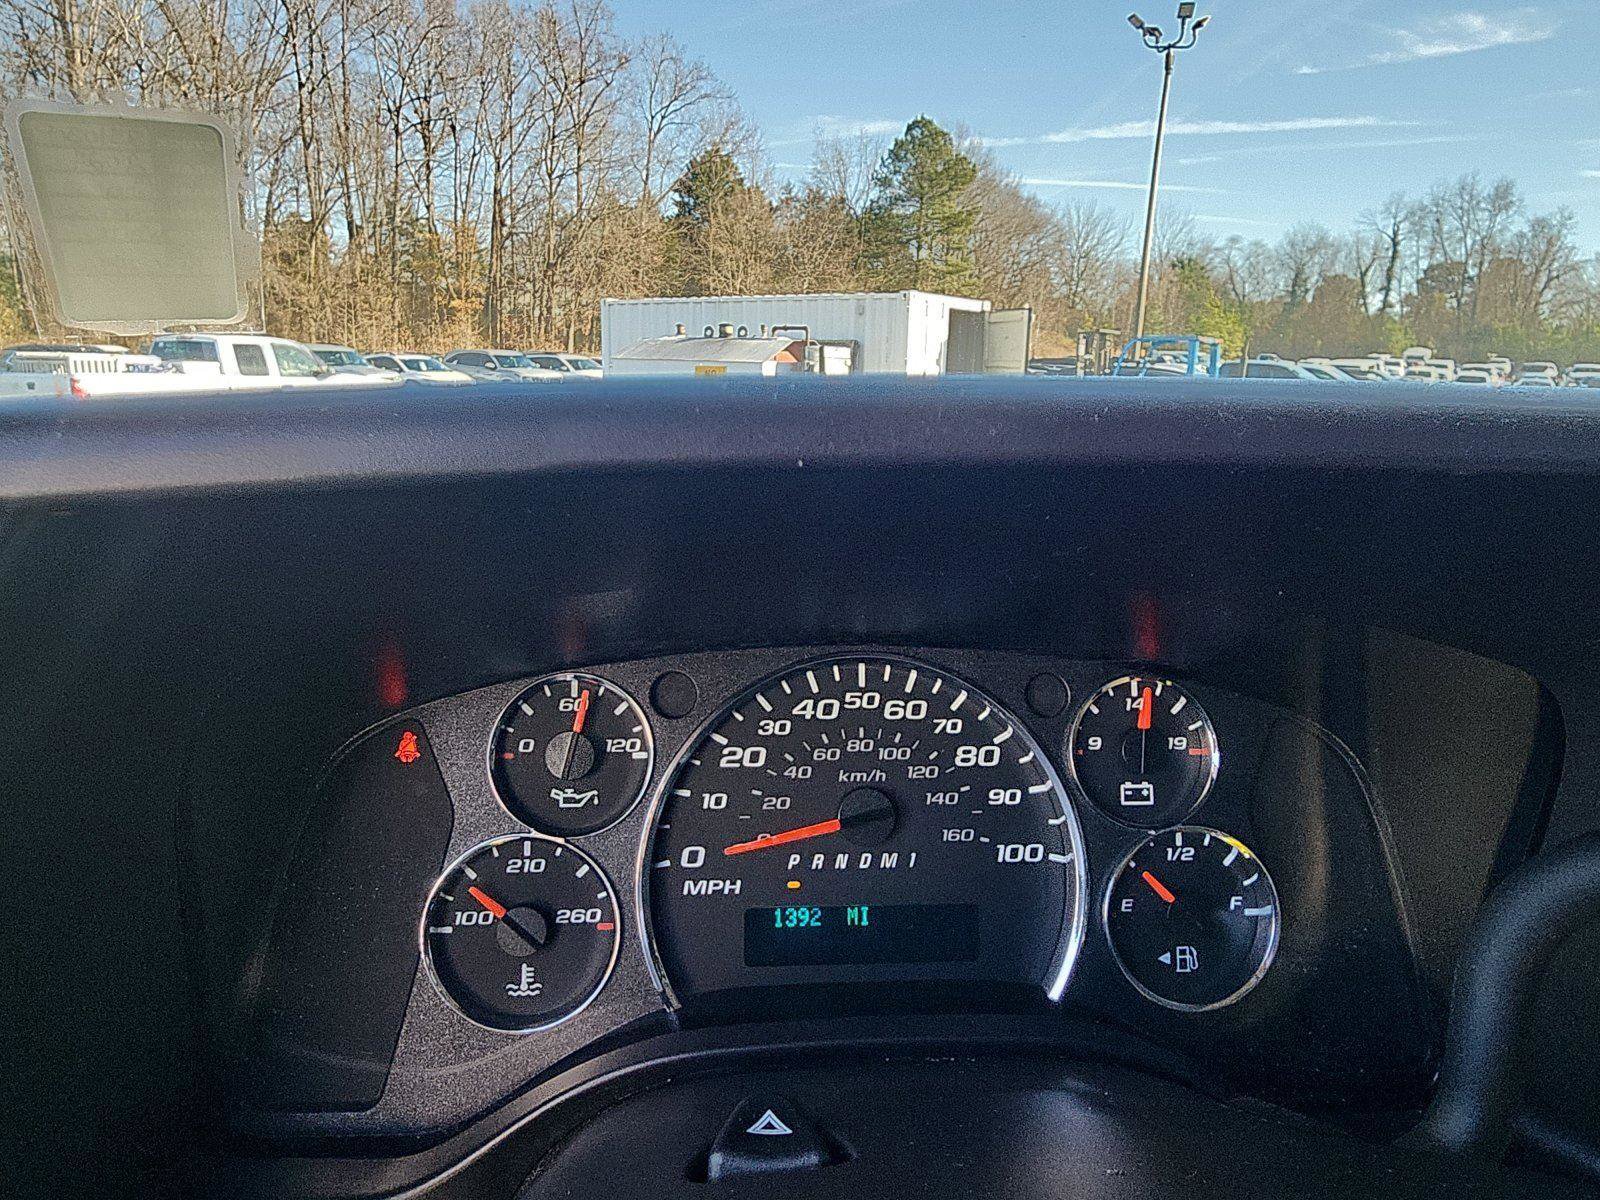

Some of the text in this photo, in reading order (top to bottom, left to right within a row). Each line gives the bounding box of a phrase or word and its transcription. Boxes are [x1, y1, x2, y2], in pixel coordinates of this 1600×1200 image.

[558, 698, 590, 712] 60
[844, 692, 881, 709] 50
[791, 698, 840, 720] 40
[883, 699, 928, 720] 60
[757, 719, 792, 736] 30
[932, 718, 963, 734] 70
[518, 738, 536, 753] 0
[606, 738, 642, 753] 120
[846, 739, 875, 752] 80
[1087, 736, 1103, 750] 9
[1168, 736, 1188, 750] 19
[719, 746, 767, 768] 20
[813, 748, 841, 761] 60
[878, 747, 911, 760] 100
[954, 745, 1001, 767] 80
[783, 765, 813, 779] 40
[838, 769, 887, 782] km/h
[907, 765, 939, 779] 120
[702, 792, 729, 810] 10
[762, 796, 791, 811] 20
[925, 792, 959, 805] 140
[988, 788, 1022, 806] 90
[942, 829, 975, 842] 160
[680, 846, 706, 868] 0
[996, 843, 1045, 863] 100
[1166, 847, 1195, 861] 1/2
[505, 858, 546, 874] 210
[787, 853, 801, 870] P
[835, 853, 849, 870] N
[859, 852, 872, 869] D
[880, 852, 899, 869] M
[683, 879, 742, 896] MPH
[1121, 898, 1134, 912] E
[1230, 896, 1243, 910] F
[454, 910, 495, 926] 100
[555, 908, 602, 924] 260
[774, 906, 869, 928] 1392 MI
